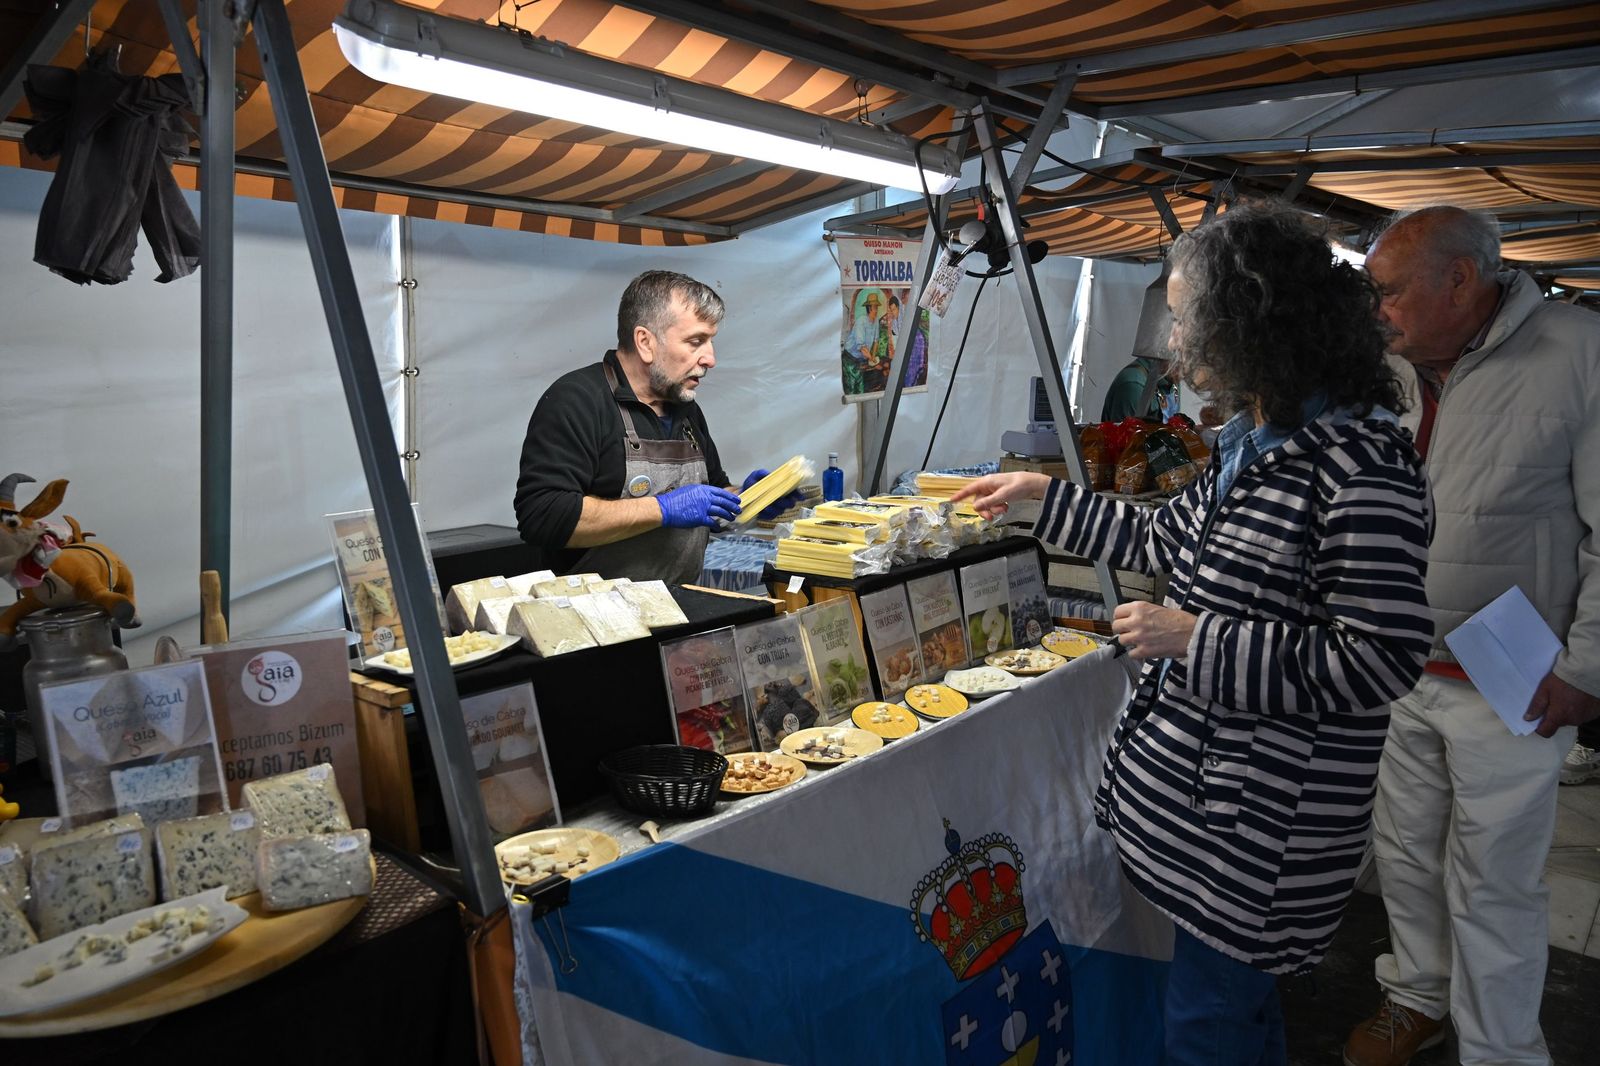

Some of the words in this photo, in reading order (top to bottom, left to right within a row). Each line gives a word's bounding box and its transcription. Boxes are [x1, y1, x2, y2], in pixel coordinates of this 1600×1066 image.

[854, 260, 913, 282] TORRALBA
[345, 536, 374, 549] Queso
[363, 548, 382, 562] CON
[711, 656, 731, 666] Cabra
[758, 652, 770, 664] CON
[770, 648, 790, 662] TRUFA
[74, 700, 138, 722] Queso
[143, 688, 184, 709] Azul
[496, 706, 526, 722] Cabra
[220, 730, 294, 756] ceptamos
[299, 722, 344, 742] Bizum
[225, 758, 255, 782] 687
[262, 754, 282, 776] 60
[288, 750, 306, 772] 75
[314, 746, 334, 764] 43
